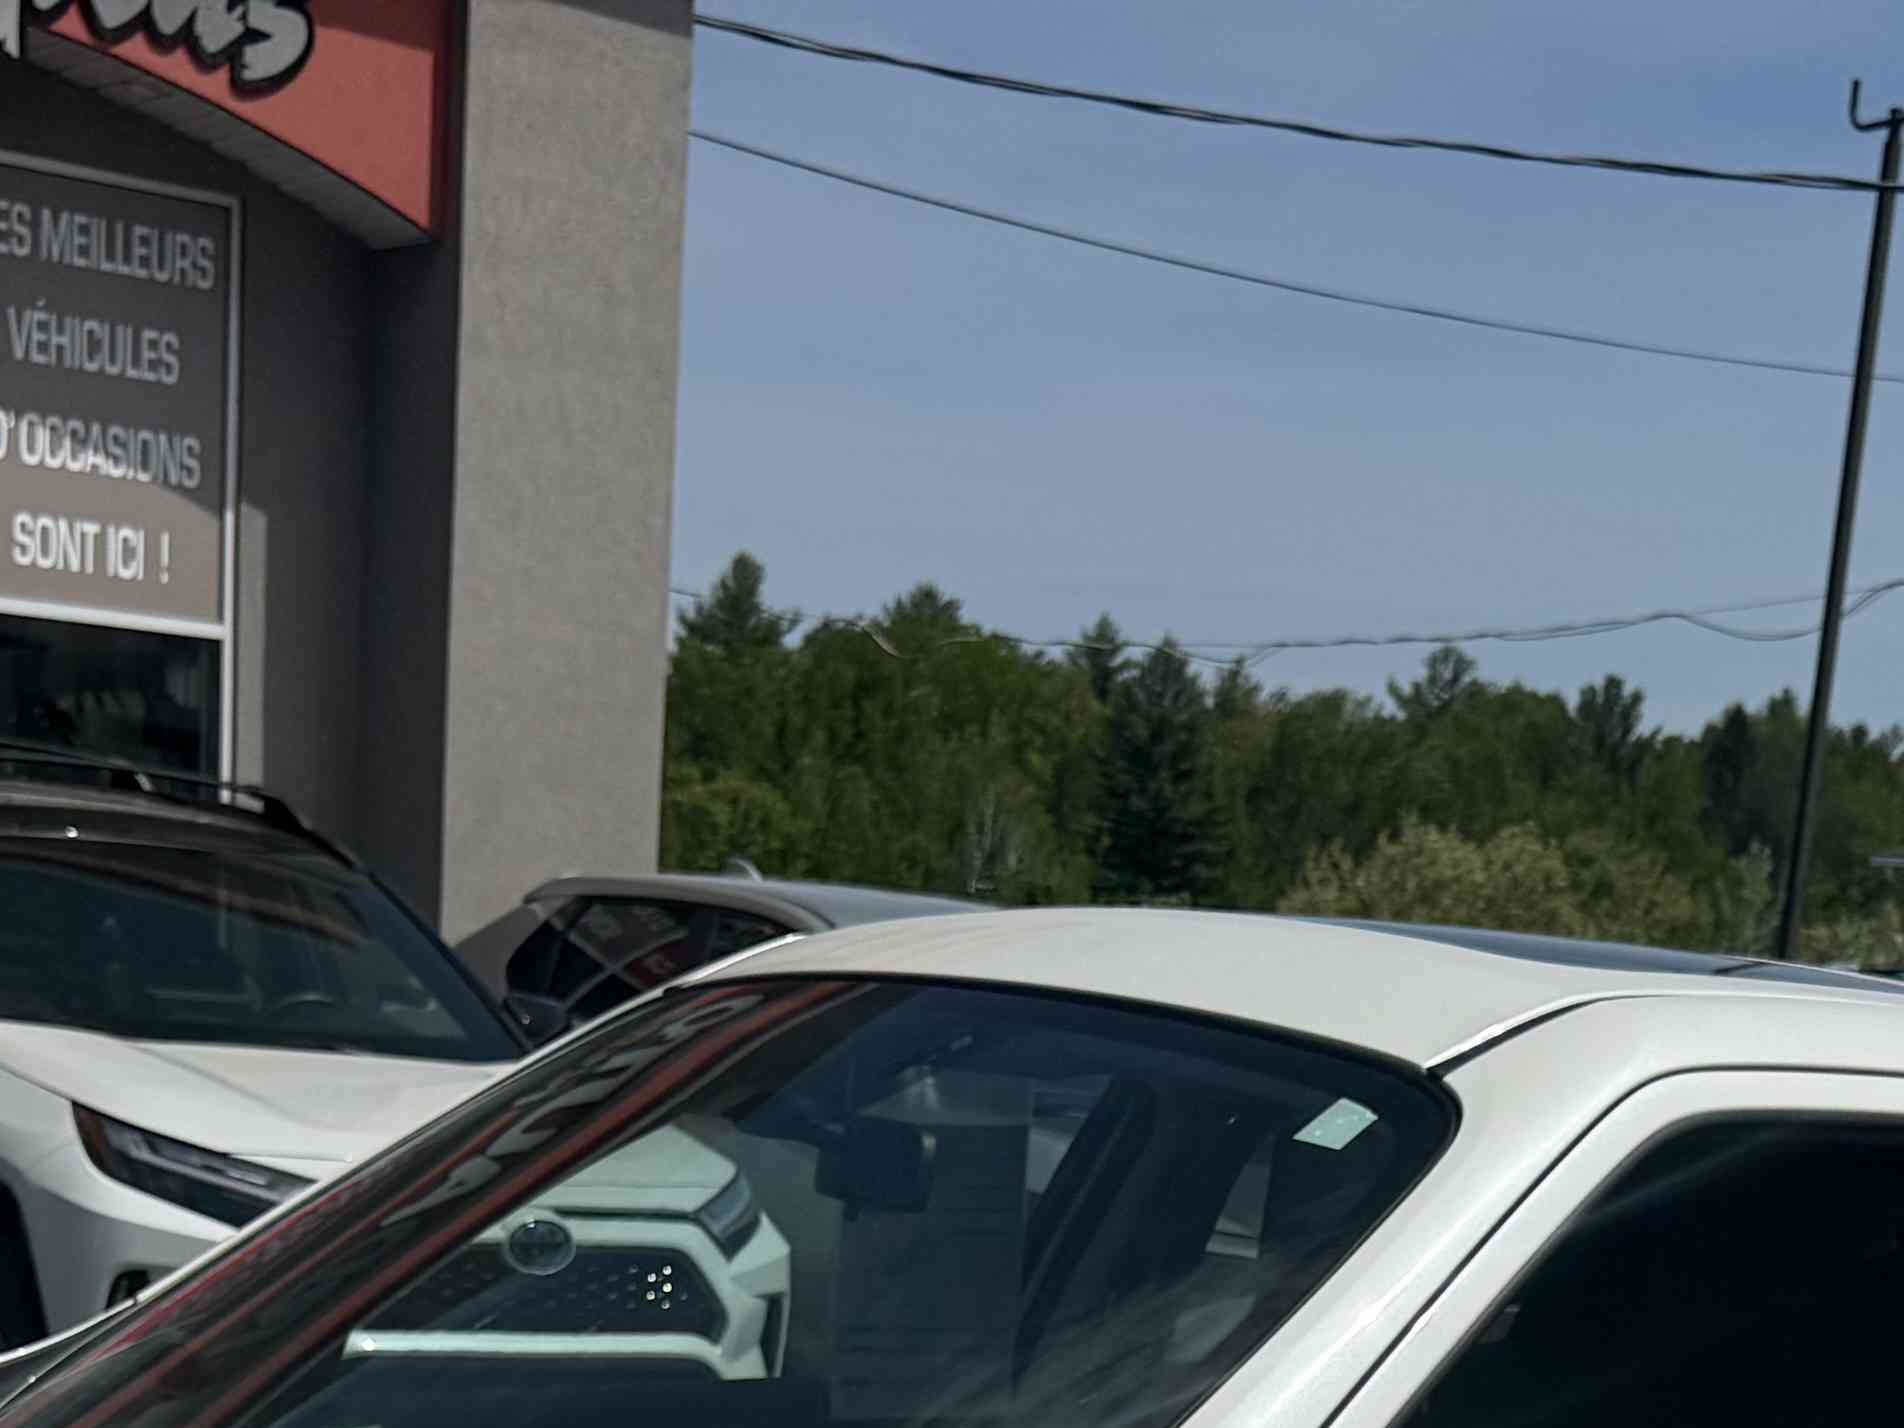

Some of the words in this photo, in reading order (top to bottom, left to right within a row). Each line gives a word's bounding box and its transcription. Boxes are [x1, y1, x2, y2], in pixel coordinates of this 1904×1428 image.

[40, 206, 215, 290] MEILLEURS
[6, 298, 180, 385] VÉHICULES
[12, 511, 99, 575] SONT
[106, 525, 145, 580] ICI
